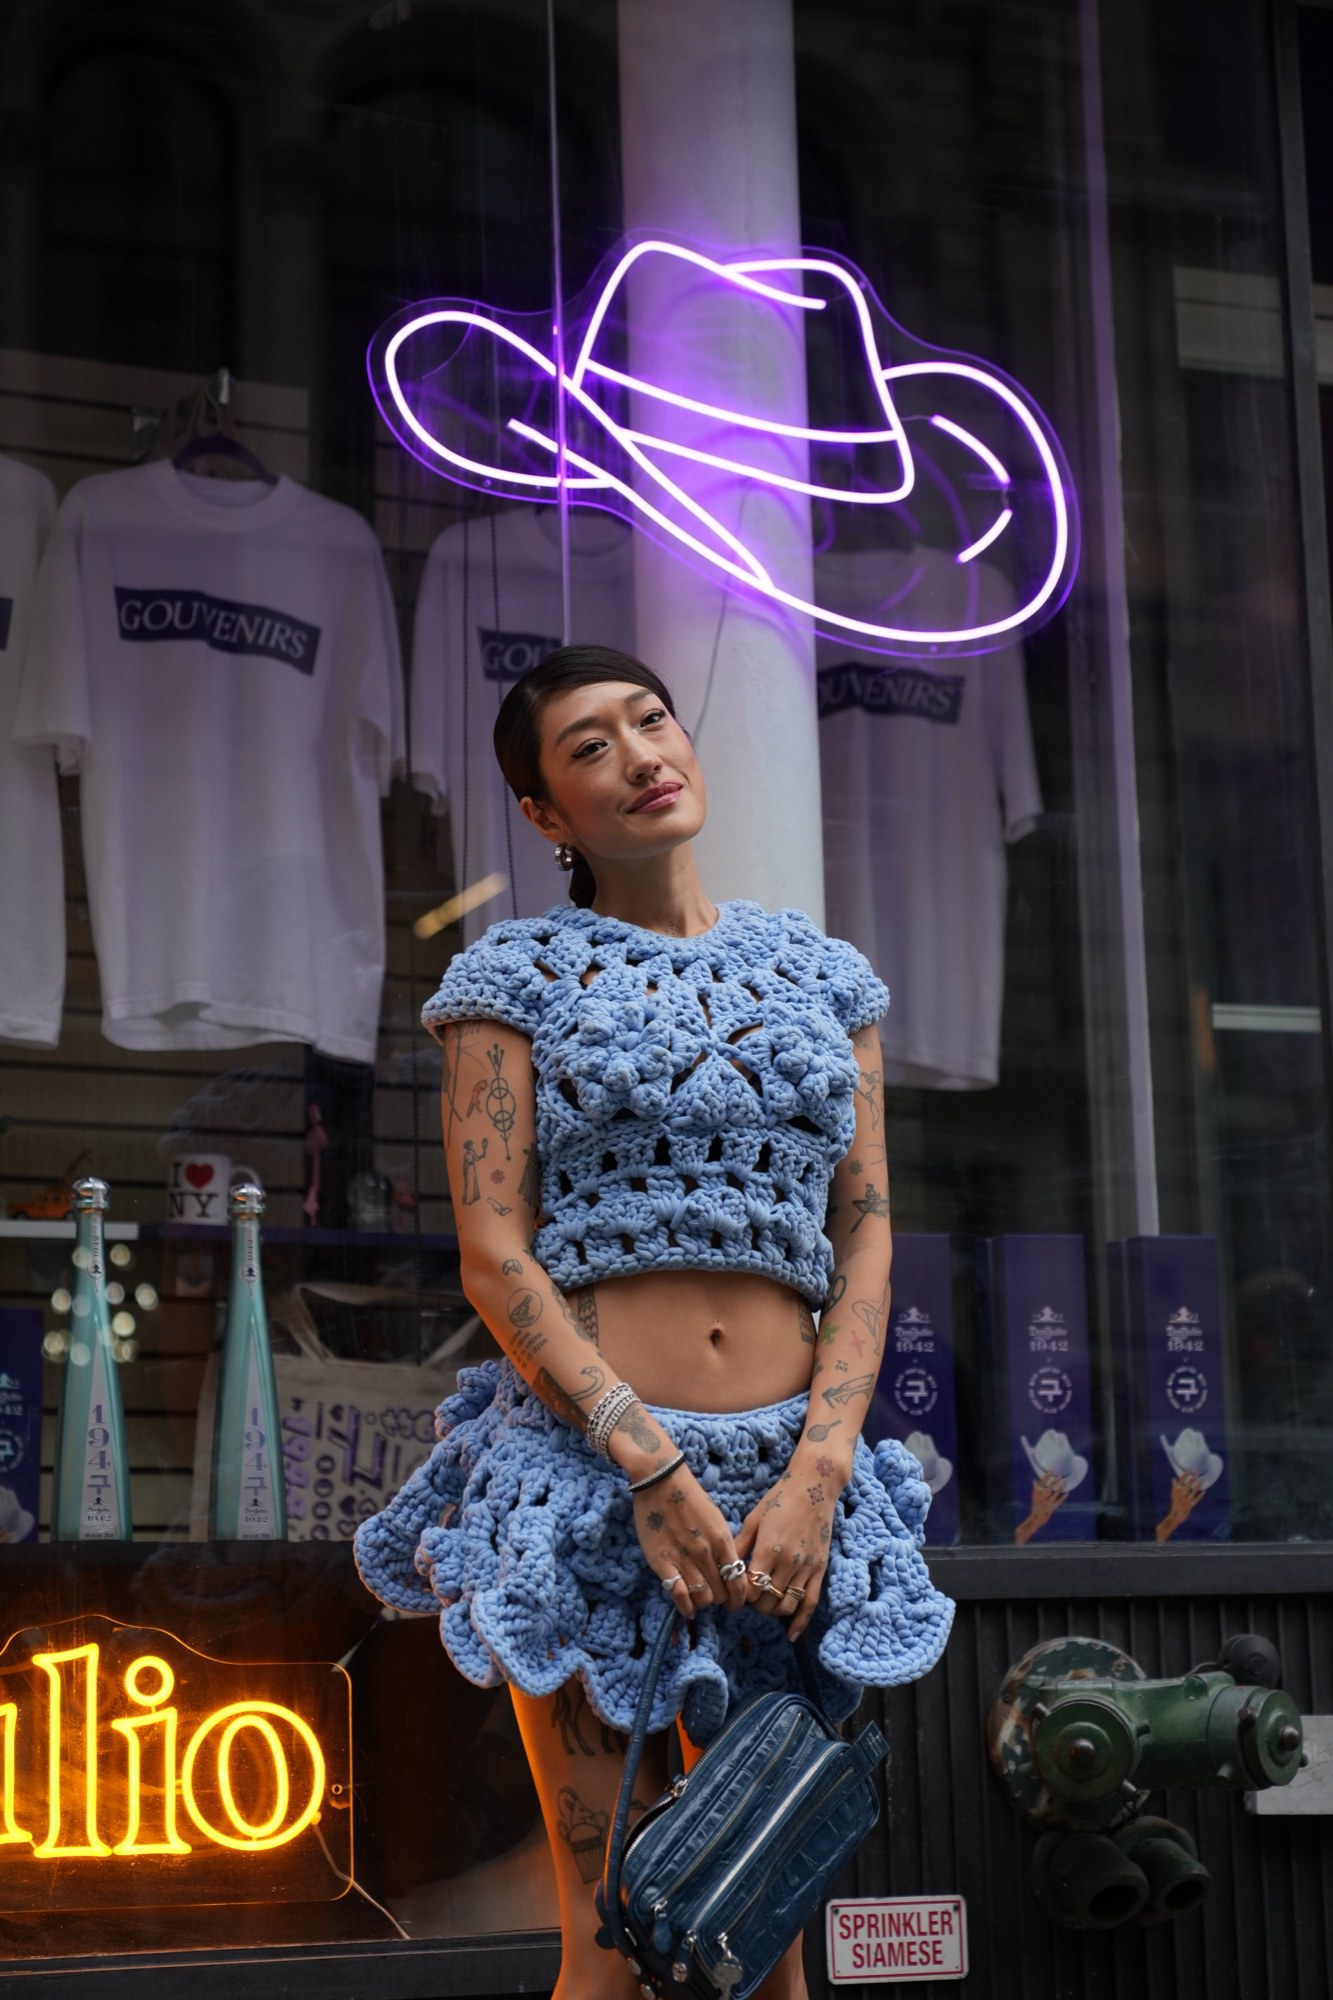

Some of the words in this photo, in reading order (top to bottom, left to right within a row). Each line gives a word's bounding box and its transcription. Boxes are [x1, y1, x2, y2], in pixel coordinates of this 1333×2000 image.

[119, 598, 309, 660] GOUVENIRS
[172, 1161, 182, 1188] I
[168, 1191, 218, 1218] NY
[895, 1341, 935, 1353] 1942
[1029, 1340, 1069, 1352] 1942
[1167, 1340, 1205, 1352] 1942
[838, 1908, 954, 1940] SPRINKLER
[851, 1938, 944, 1969] SIAMESE
